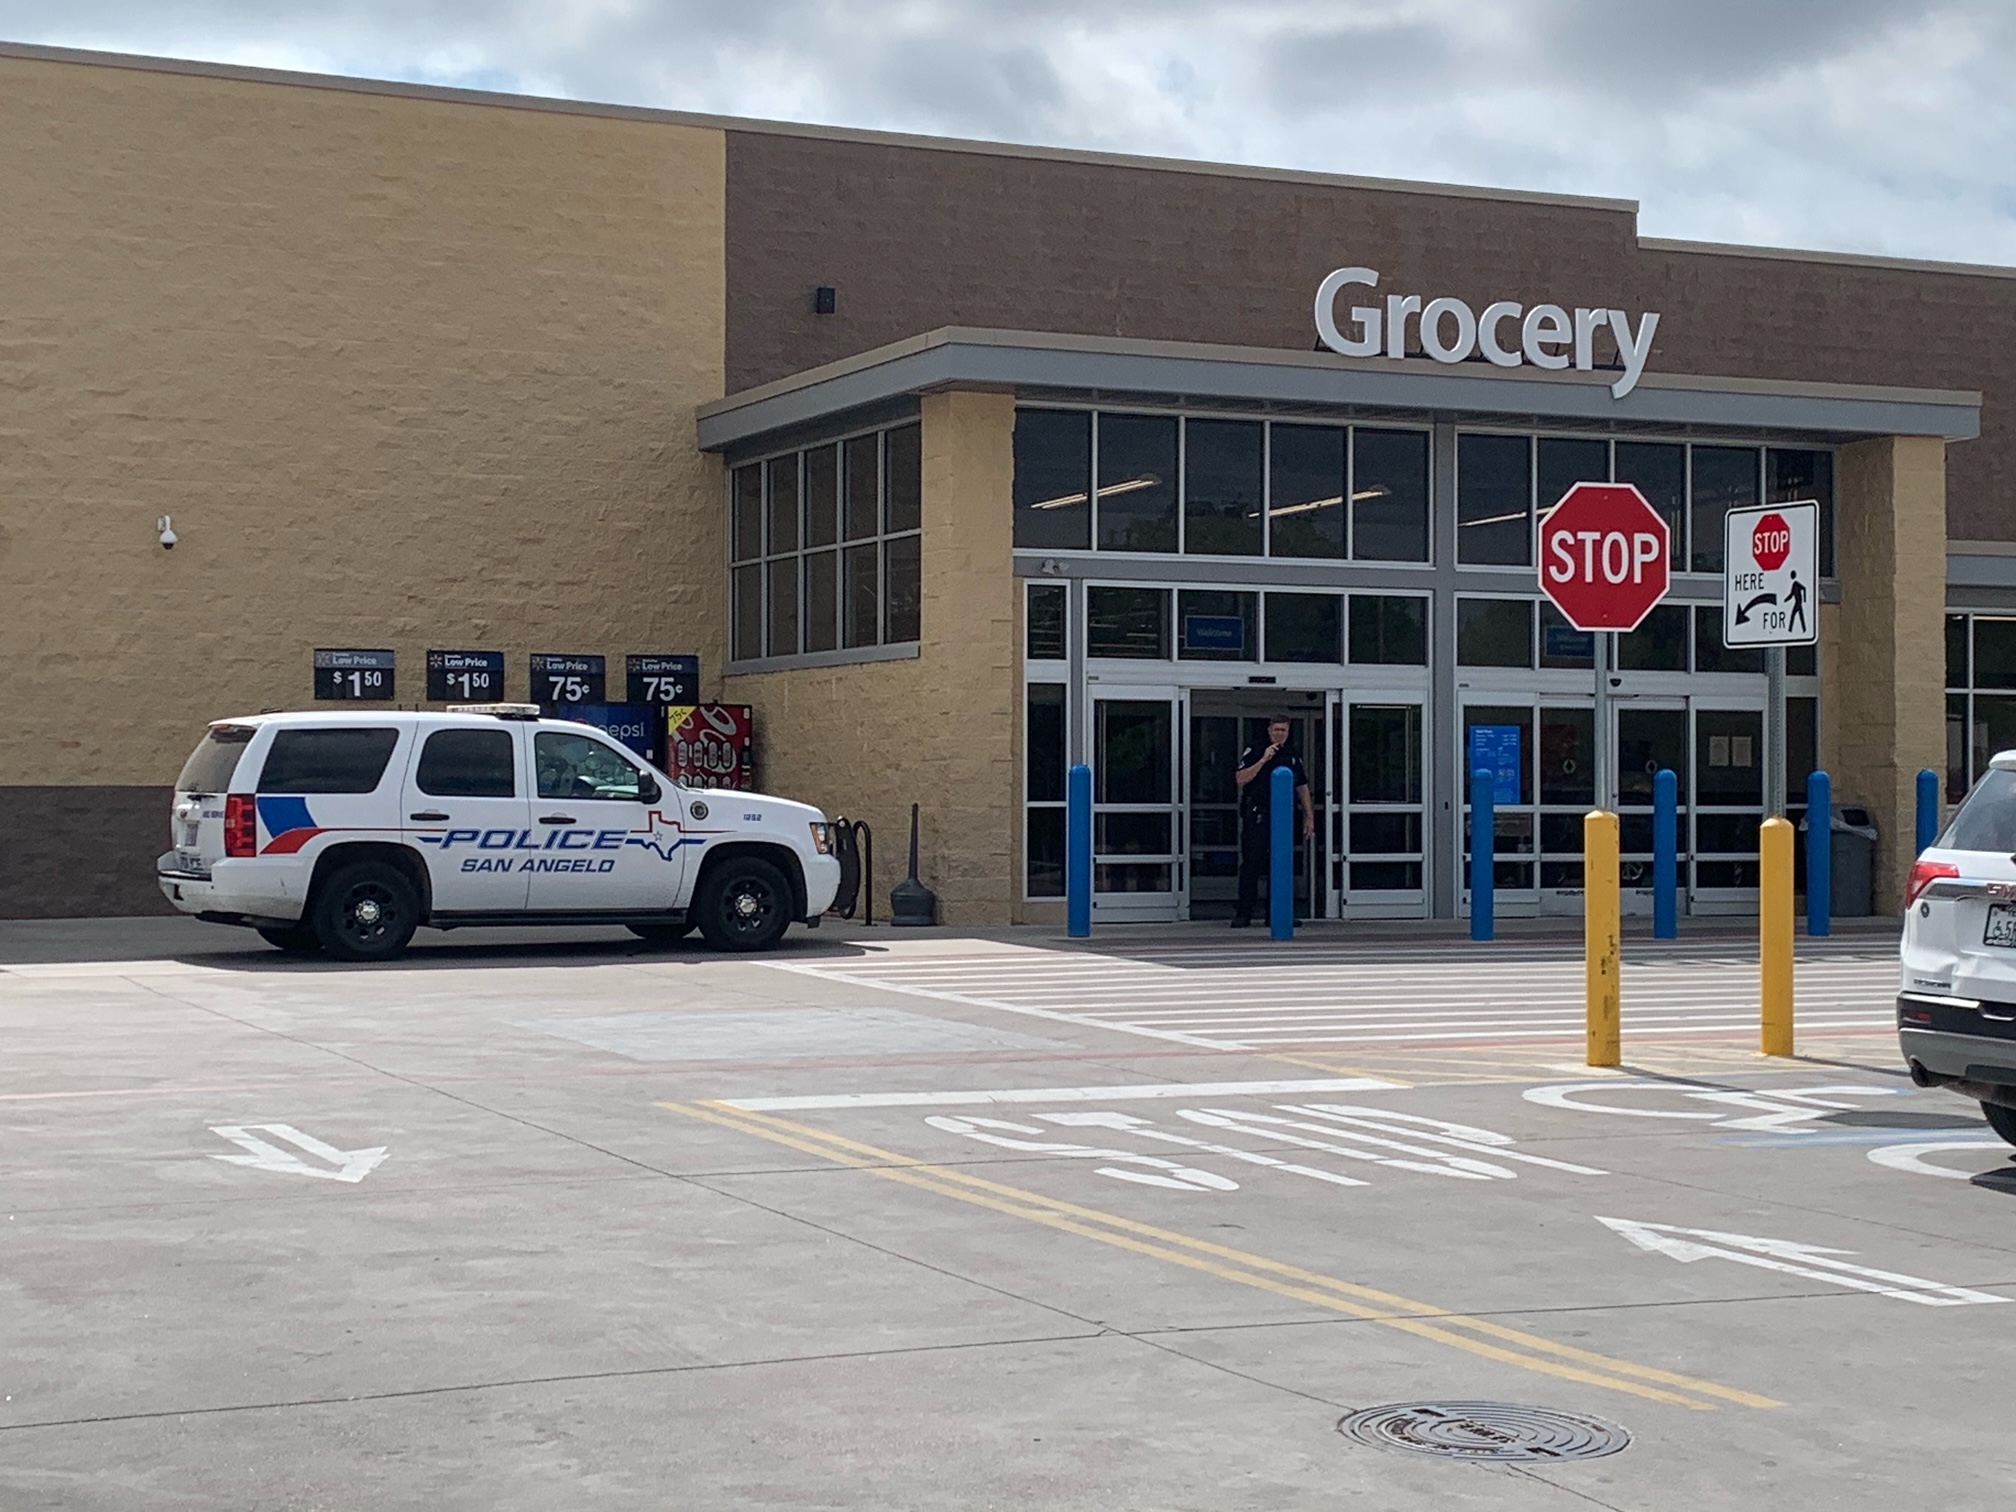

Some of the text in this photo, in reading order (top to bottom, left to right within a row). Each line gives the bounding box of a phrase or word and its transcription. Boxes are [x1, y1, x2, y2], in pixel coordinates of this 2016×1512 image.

[1315, 267, 1661, 400] Grocery
[1754, 530, 1789, 555] STOP
[1549, 530, 1660, 584] STOP
[1735, 573, 1764, 591] HERE
[1763, 611, 1786, 630] FOR
[332, 656, 377, 665] Low Price
[444, 657, 488, 667] Low Price
[546, 661, 588, 671] Low Price
[642, 661, 683, 671] Low Price
[440, 829, 628, 850] POLICE
[460, 858, 615, 873] SAN ANGELO
[925, 1103, 1611, 1192] STOP
